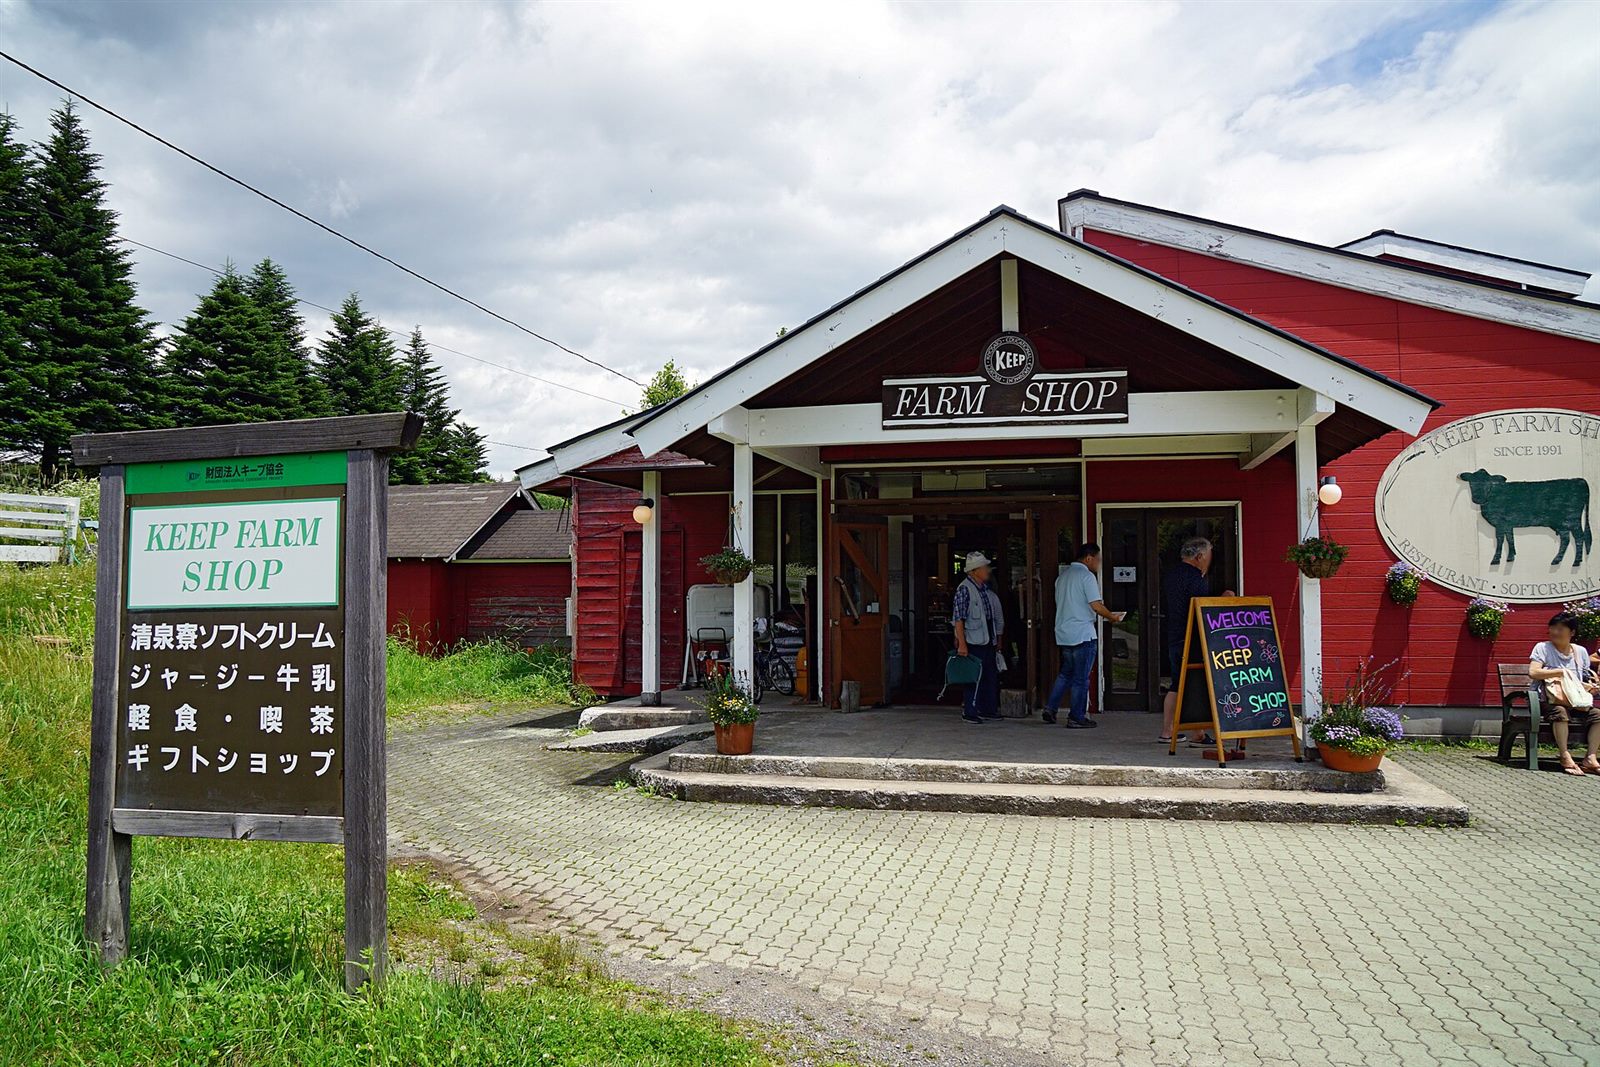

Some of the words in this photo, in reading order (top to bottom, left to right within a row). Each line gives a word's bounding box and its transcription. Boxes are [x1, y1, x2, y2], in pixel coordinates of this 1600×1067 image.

[995, 350, 1026, 371] KEEP
[892, 384, 990, 417] FARM
[1020, 380, 1118, 413] SHOP
[1427, 421, 1485, 456] KEEP
[1491, 415, 1561, 435] FARM
[1493, 446, 1533, 457] SINCE
[1537, 445, 1562, 456] 1991
[144, 521, 229, 551] KEEP
[234, 517, 322, 548] FARM
[182, 559, 283, 592] SHOP
[1398, 537, 1489, 591] RESTAURANT
[1501, 577, 1596, 596] SOFTCREAM
[1207, 611, 1271, 630] WELCOME
[130, 622, 336, 650] 清泉寮ソフトクリーム
[1225, 634, 1250, 649] TO
[1212, 648, 1252, 670] KEEP
[130, 663, 336, 692] ジャージー牛乳
[1230, 667, 1273, 688] FARM
[1249, 692, 1287, 713] SHOP
[127, 744, 336, 777] ギフトショップ
